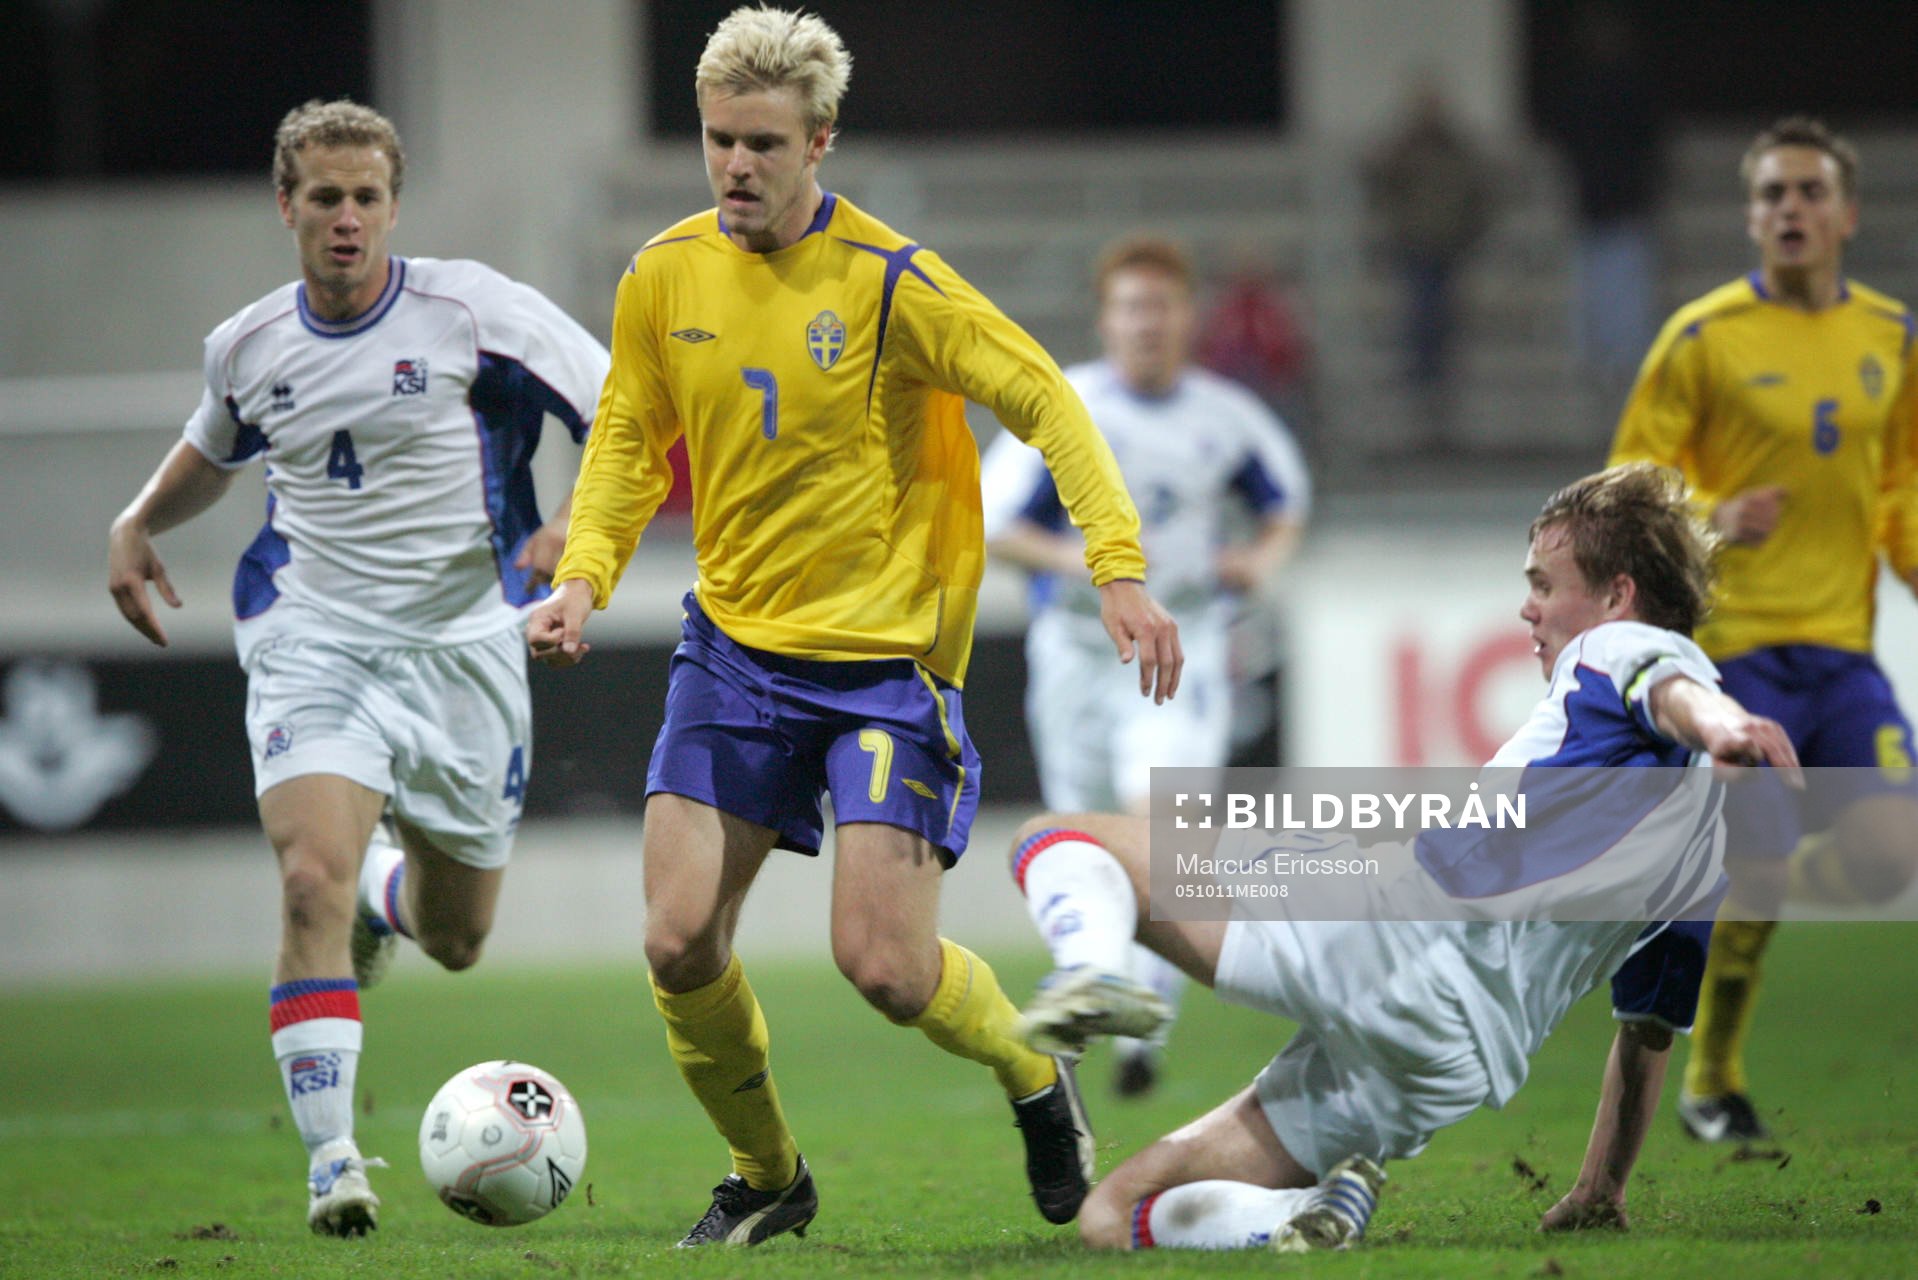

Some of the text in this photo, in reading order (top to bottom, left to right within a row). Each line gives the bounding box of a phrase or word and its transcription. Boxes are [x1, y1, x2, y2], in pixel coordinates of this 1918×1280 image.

[740, 366, 778, 440] 7
[1812, 399, 1841, 457] 6
[326, 429, 364, 490] 4
[502, 746, 528, 806] 4
[858, 728, 894, 804] 7
